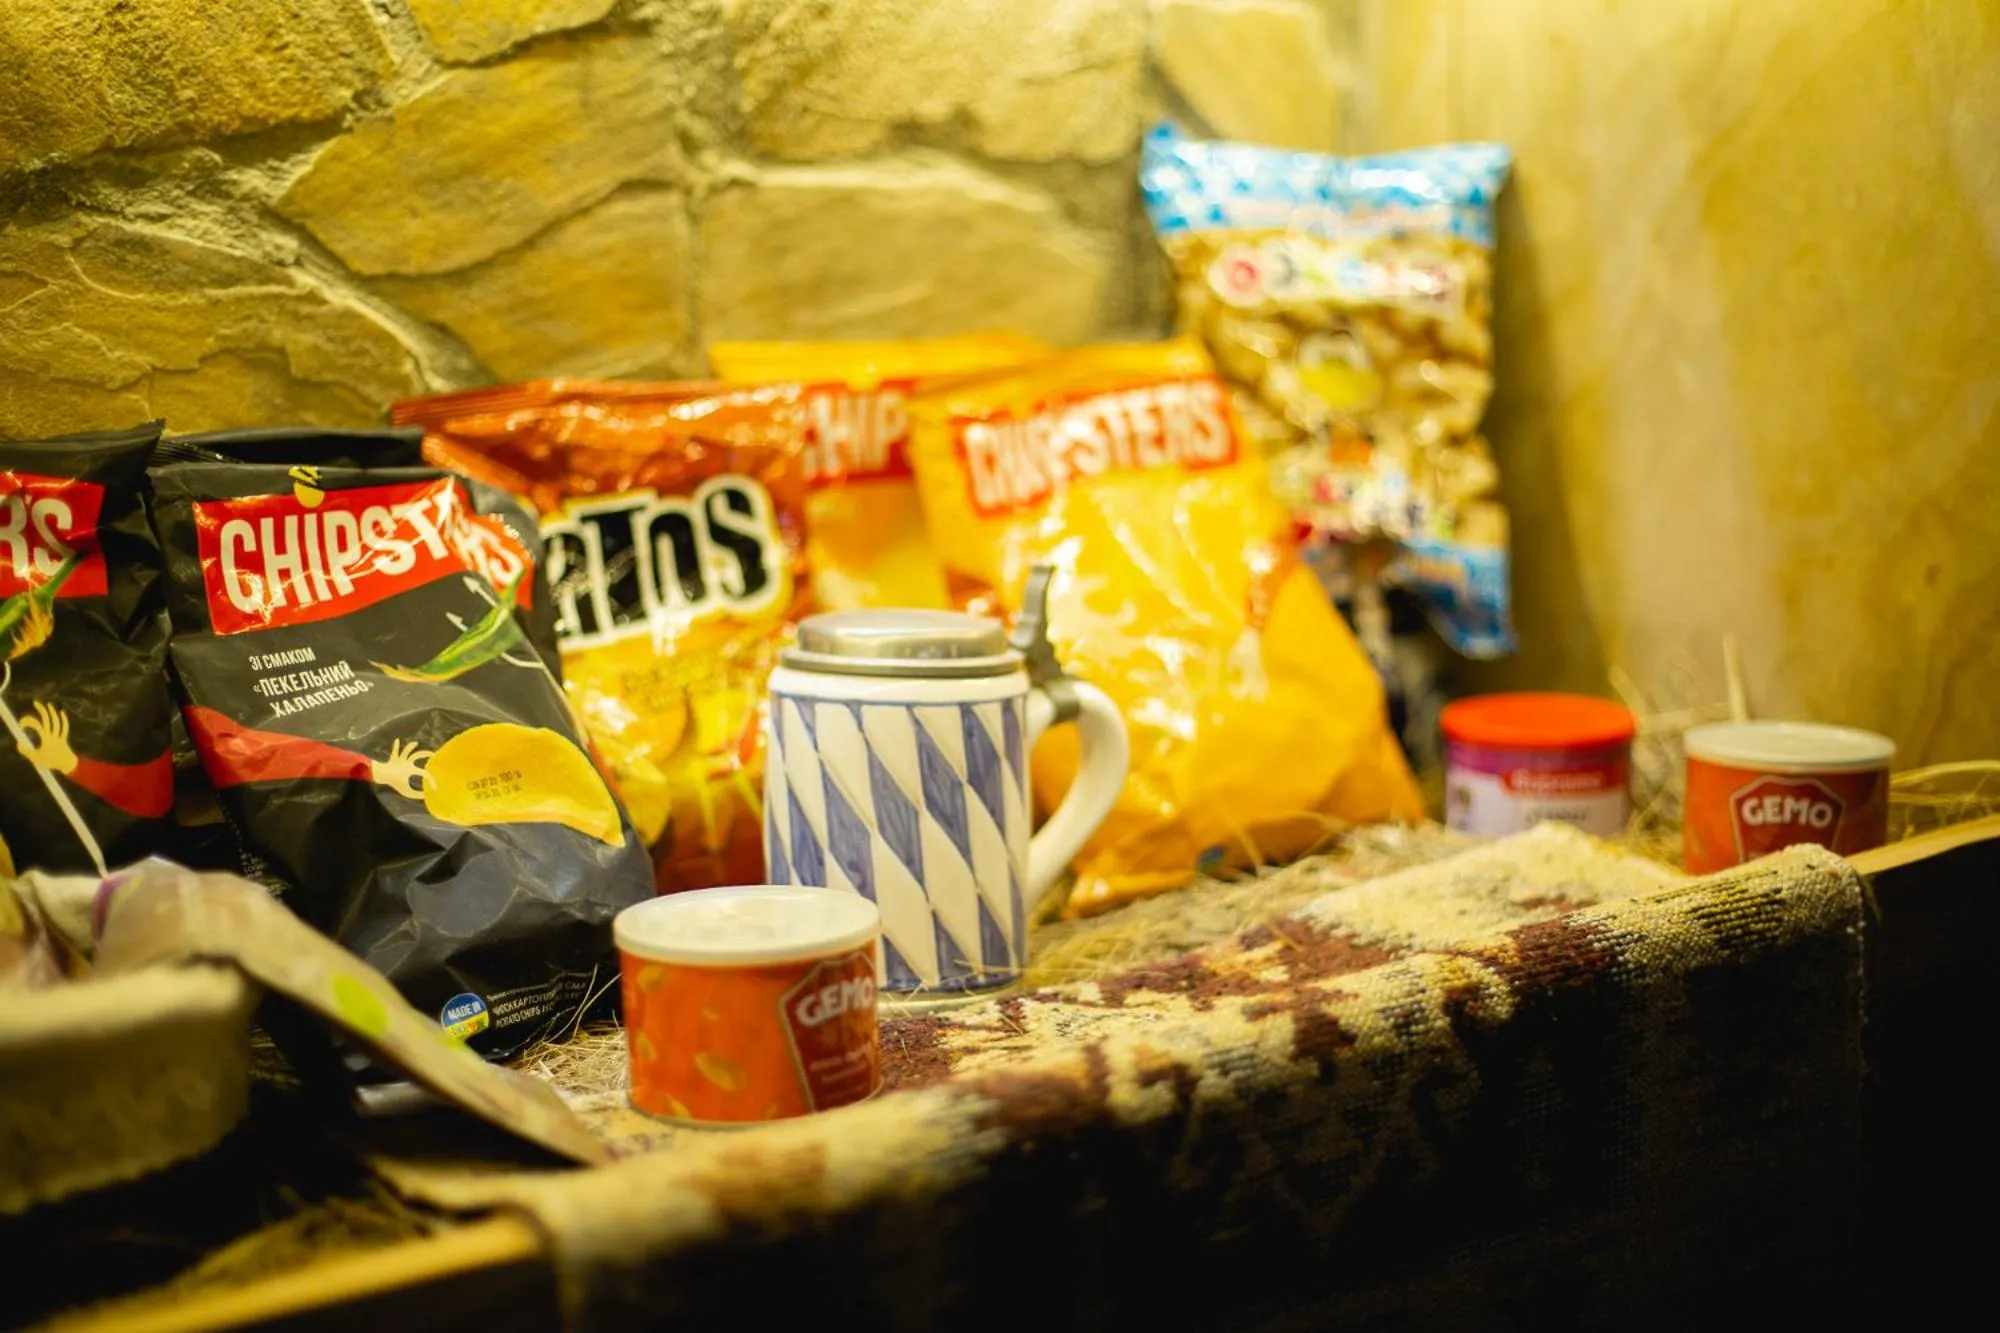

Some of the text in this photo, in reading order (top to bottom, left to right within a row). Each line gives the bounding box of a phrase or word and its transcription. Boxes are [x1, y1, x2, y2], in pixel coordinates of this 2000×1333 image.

[262, 646, 317, 669] СМАКОМ
[1741, 794, 1833, 829] GEMO
[447, 1003, 473, 1020] MADE
[796, 976, 875, 1028] GEMO
